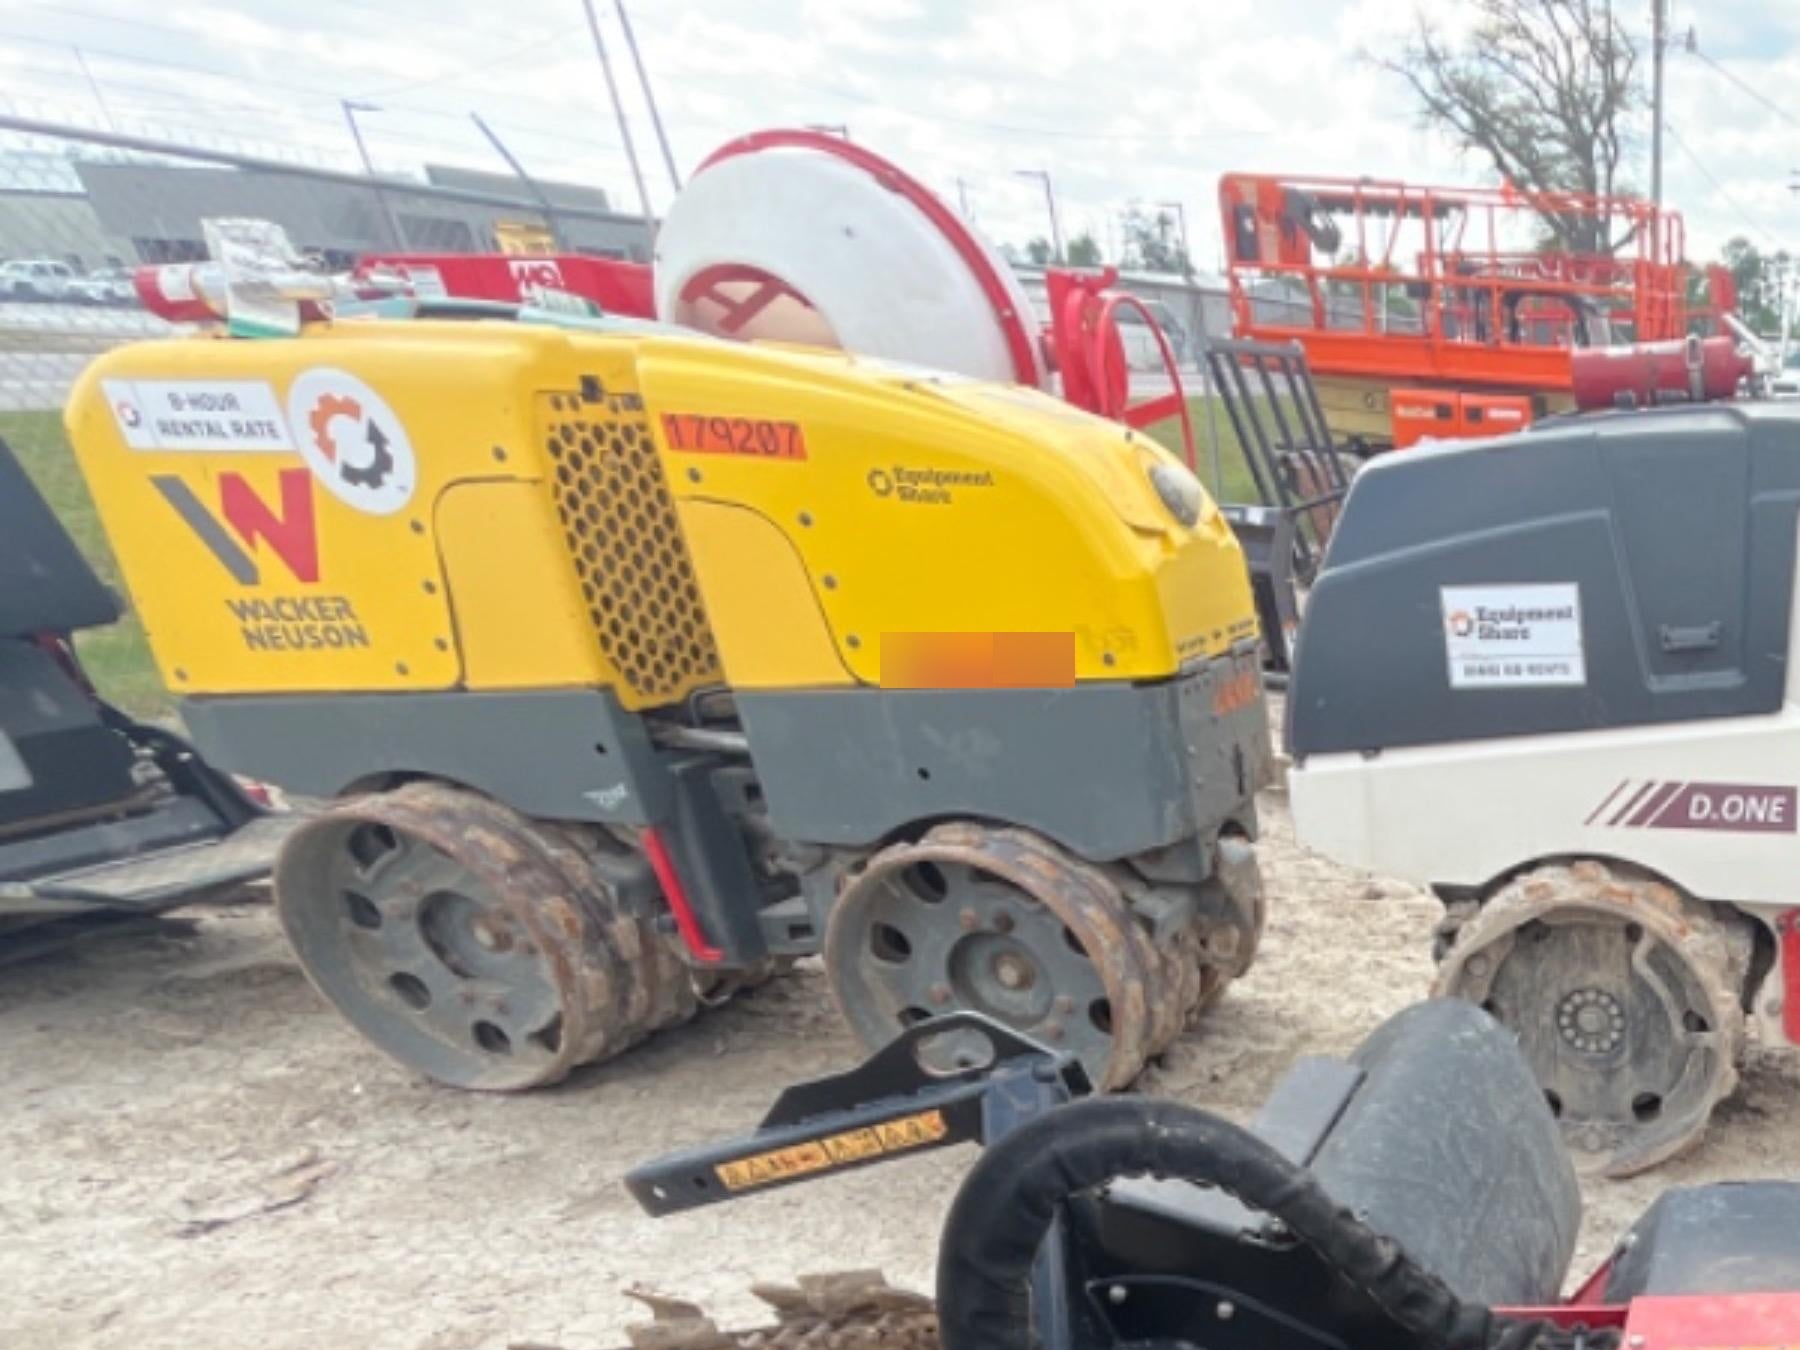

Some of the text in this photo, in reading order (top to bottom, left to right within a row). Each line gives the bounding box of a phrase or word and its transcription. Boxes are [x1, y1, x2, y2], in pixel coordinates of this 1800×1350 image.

[156, 418, 282, 441] RENTAL RATE
[665, 413, 800, 458] 179207
[225, 597, 357, 623] WACKER
[241, 624, 371, 651] NEUSON
[1687, 793, 1787, 824] D.ONE
